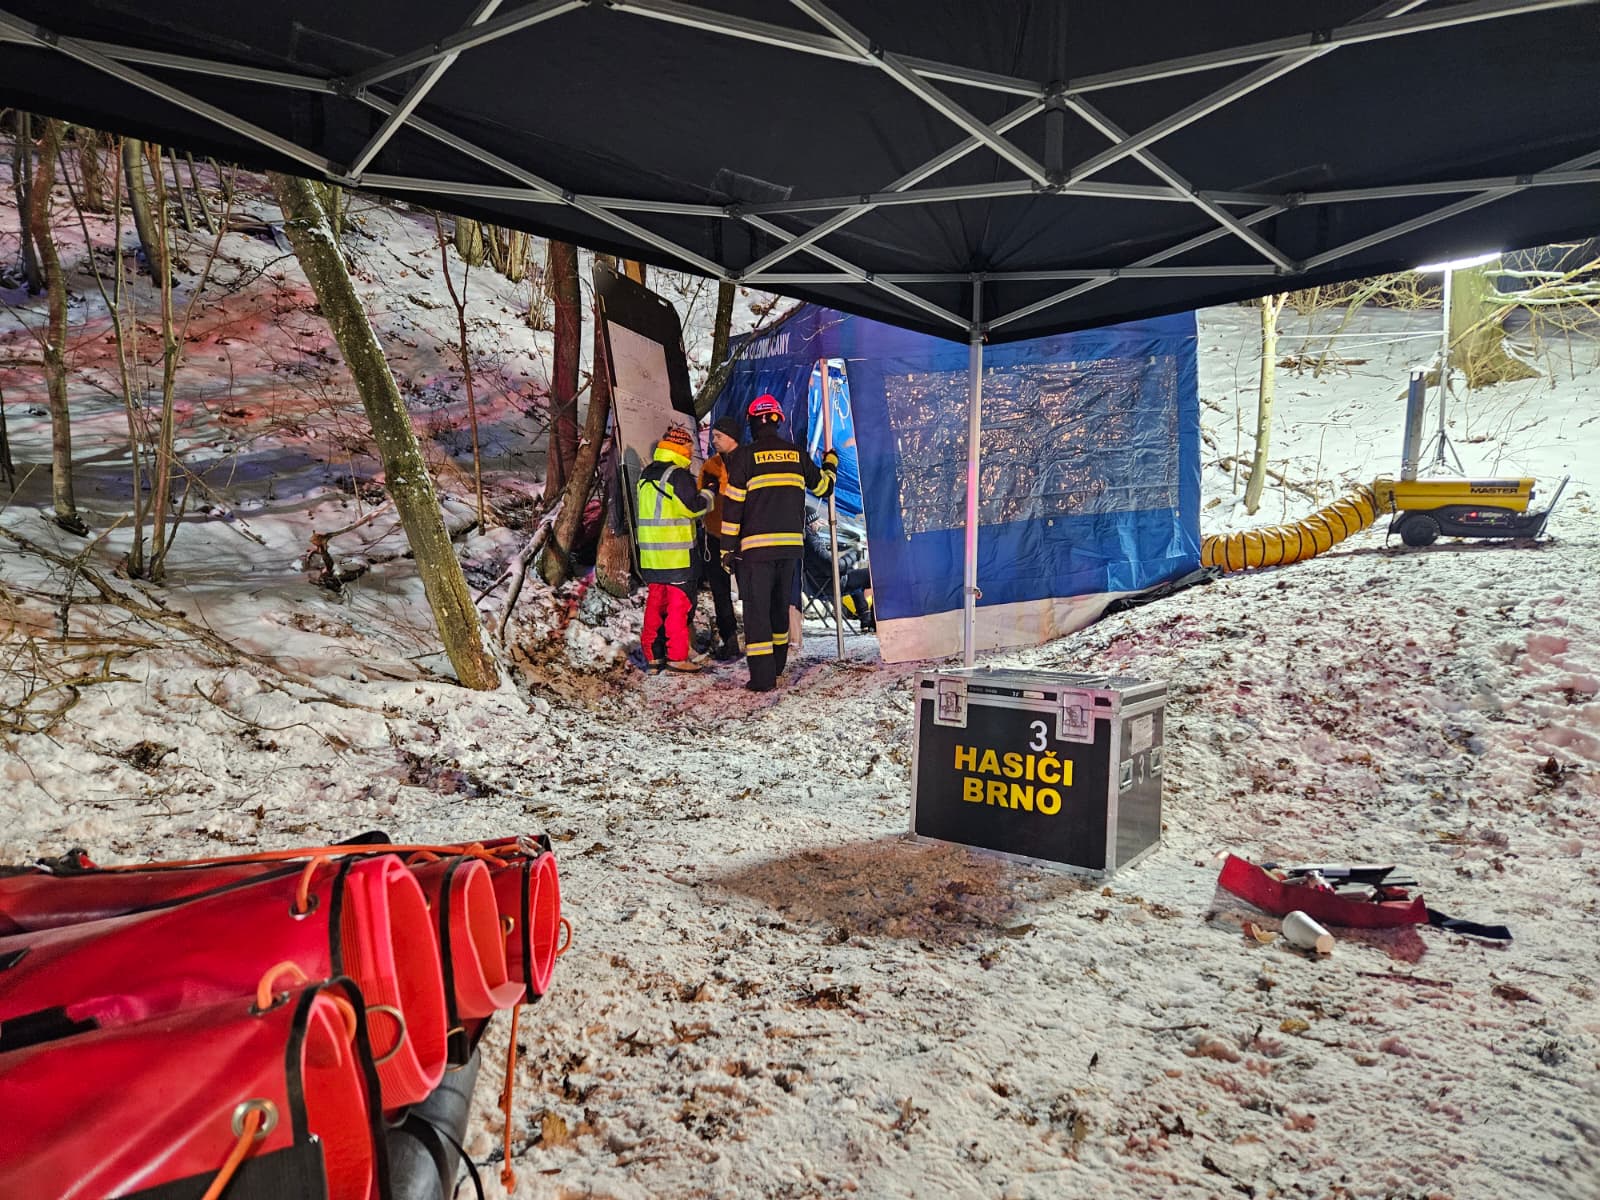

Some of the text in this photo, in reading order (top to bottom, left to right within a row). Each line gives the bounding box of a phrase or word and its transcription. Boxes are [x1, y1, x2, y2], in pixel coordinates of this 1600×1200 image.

[1470, 486, 1519, 494] MASTER
[1029, 720, 1048, 752] 3
[954, 744, 1074, 787] HASIČI
[1138, 754, 1145, 785] 3
[962, 776, 1062, 816] BRNO
